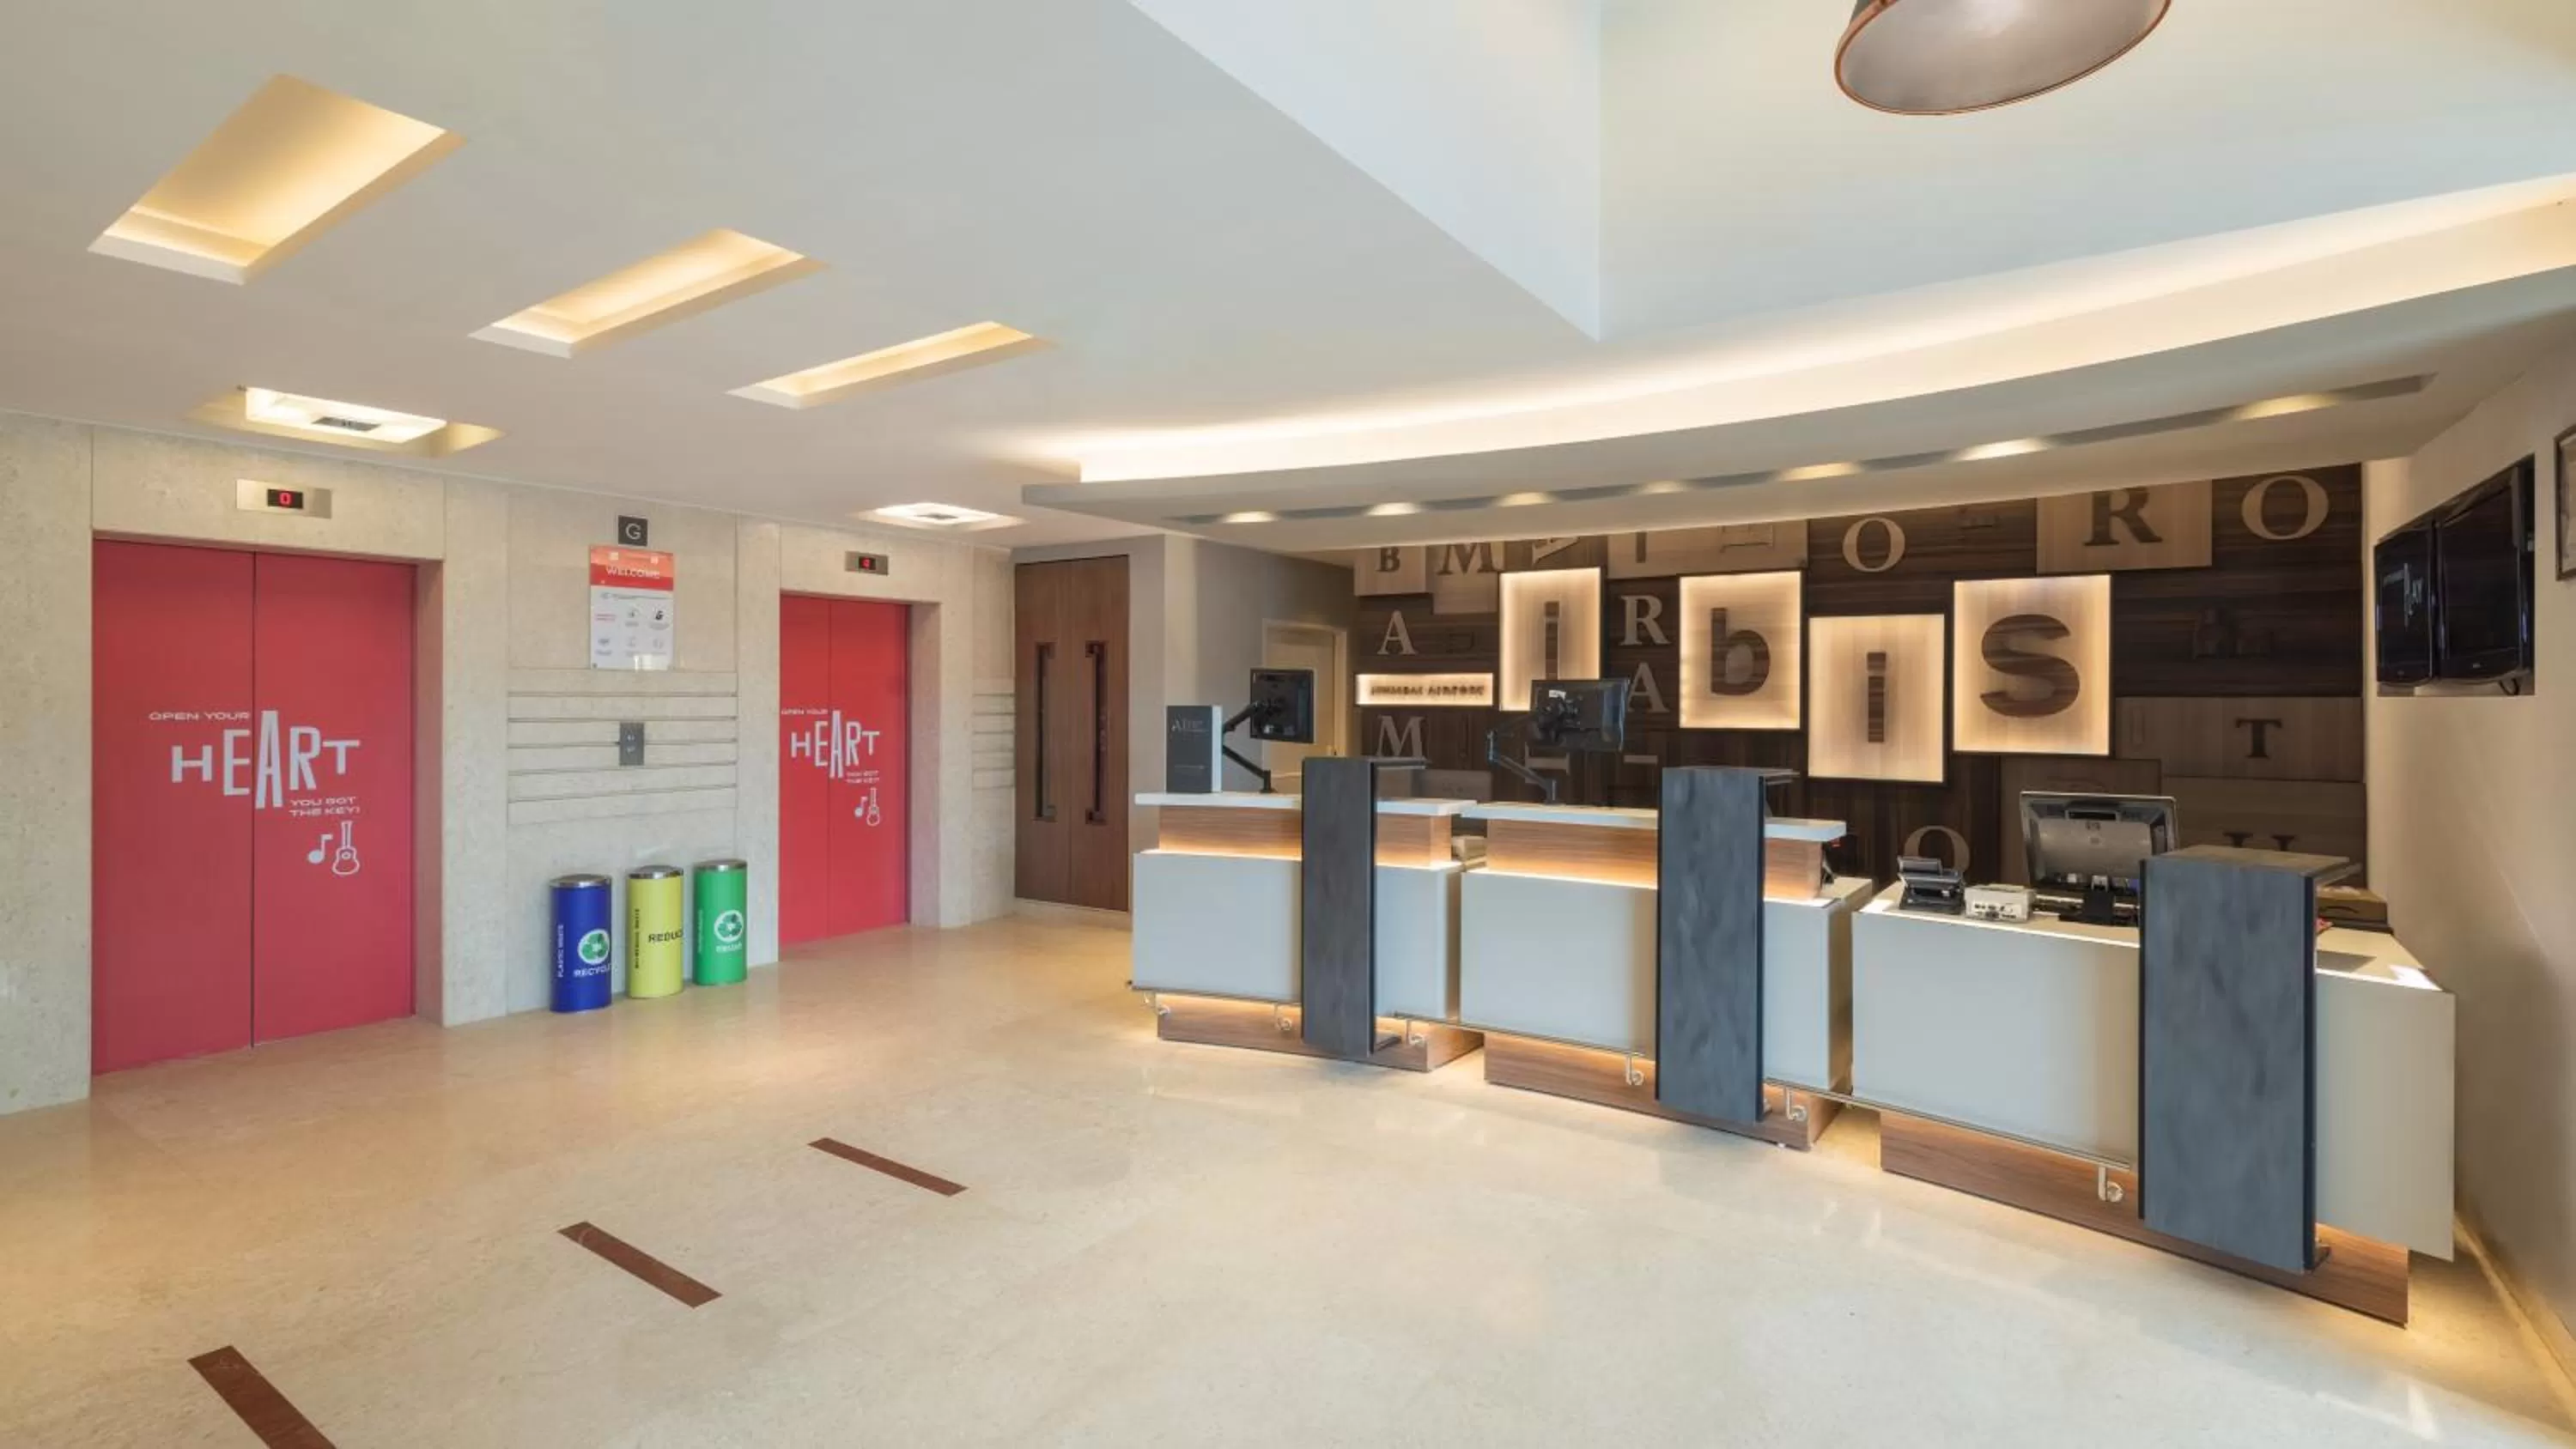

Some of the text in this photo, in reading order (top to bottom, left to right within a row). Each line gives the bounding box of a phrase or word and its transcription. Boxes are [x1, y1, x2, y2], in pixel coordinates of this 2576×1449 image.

[626, 523, 641, 540] G
[2241, 475, 2330, 541] O
[1842, 518, 1905, 573] O
[1376, 609, 1417, 656] A
[1619, 595, 1669, 646] R
[149, 712, 251, 721] OPEN YOUR
[2236, 718, 2283, 759] T
[171, 710, 361, 809] HEART
[790, 709, 880, 779] HEART
[289, 808, 322, 817] THE
[290, 796, 356, 807] YOU GOT
